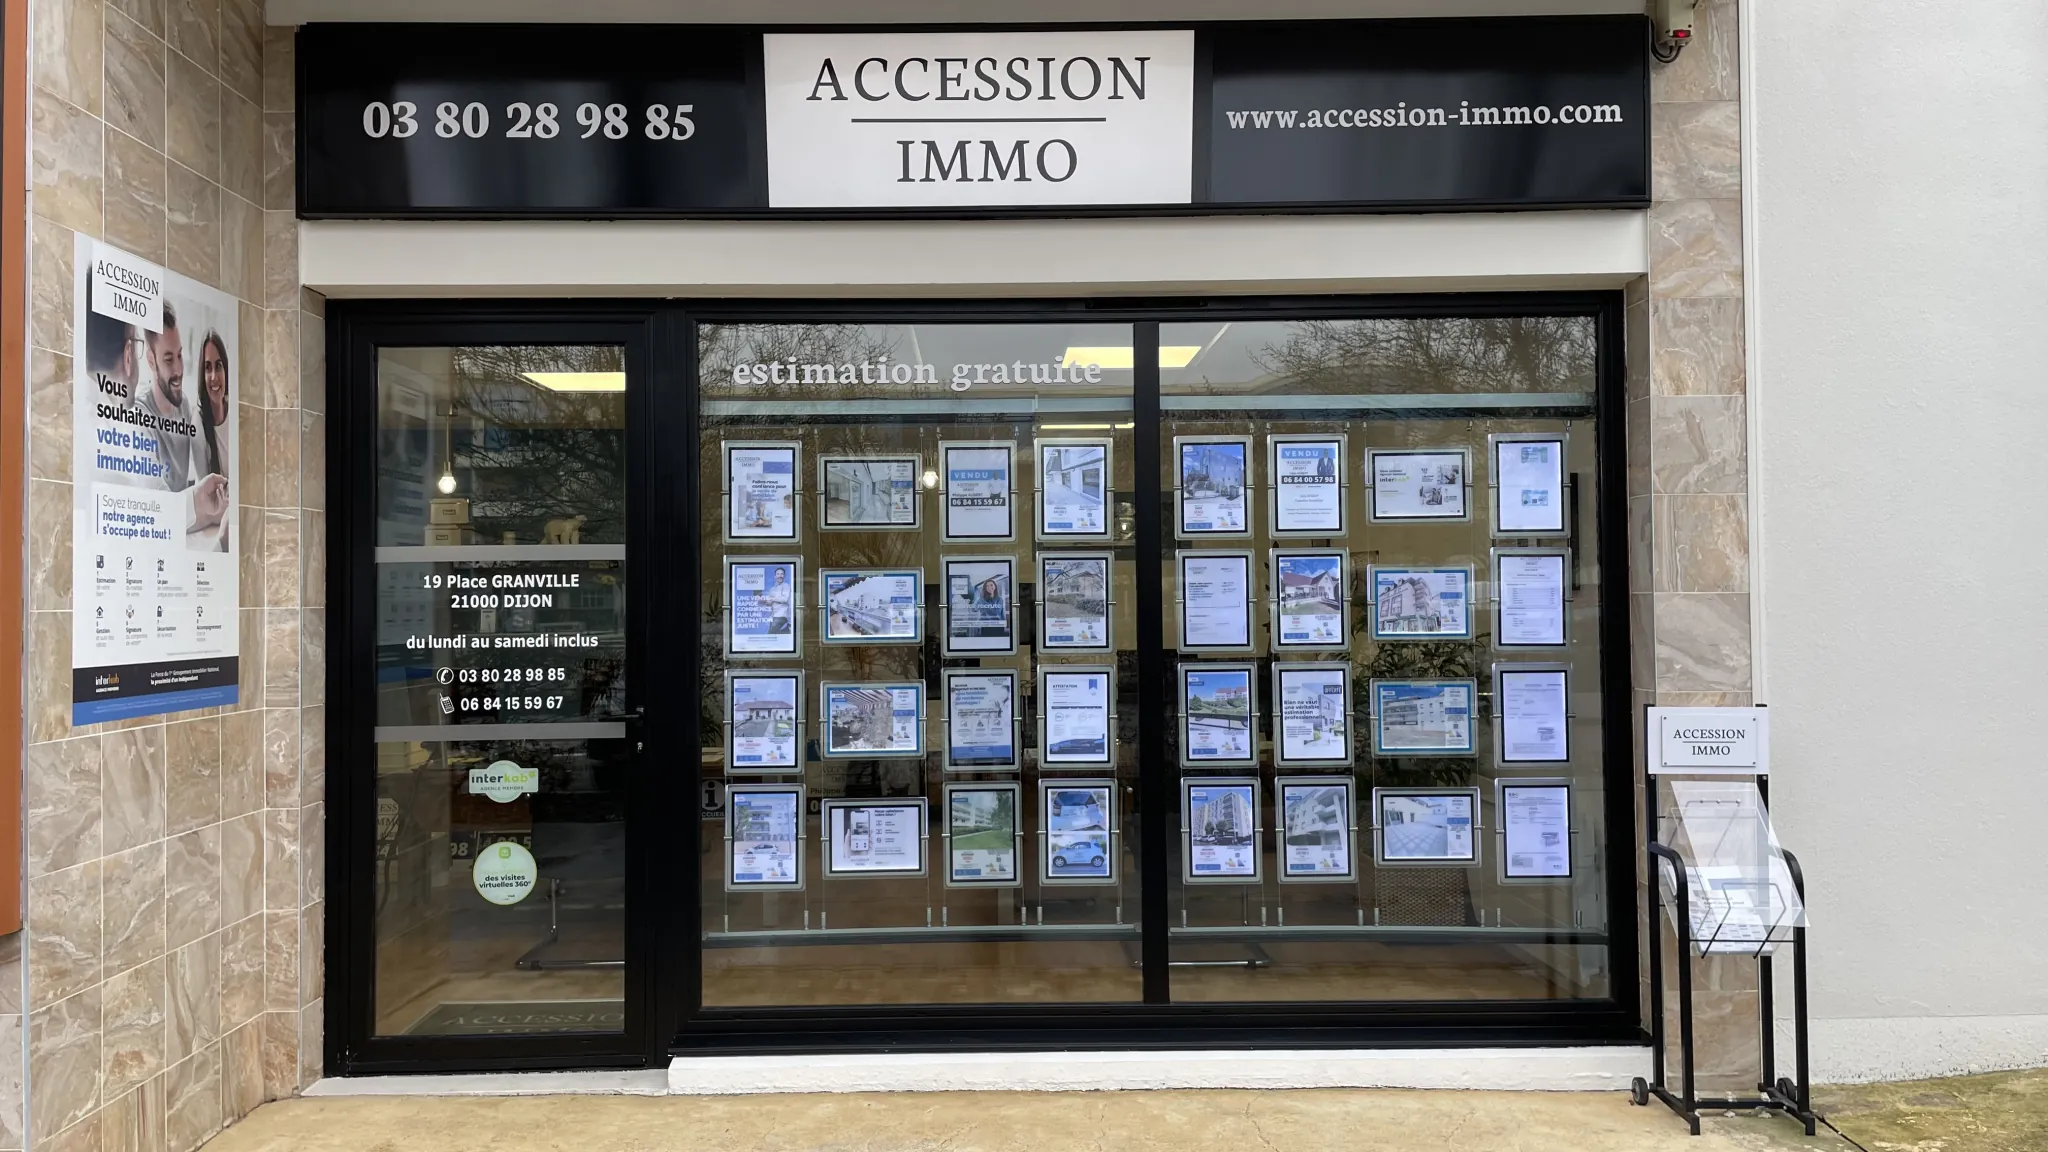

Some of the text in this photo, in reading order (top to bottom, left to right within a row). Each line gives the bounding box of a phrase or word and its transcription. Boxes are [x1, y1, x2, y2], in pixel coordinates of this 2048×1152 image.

[806, 56, 1151, 102] ACCESSION
[363, 101, 695, 140] 03 80 28 98 85
[1226, 100, 1623, 130] www.accession-immo.com
[897, 139, 1078, 183] IMMO
[97, 260, 159, 296] ACCESSION
[113, 292, 147, 318] IMMO
[733, 356, 1102, 392] estimation gratuite
[97, 373, 128, 398] Vous
[97, 403, 197, 438] souhaitez vendre
[97, 427, 158, 453] votre bien
[97, 449, 163, 477] immobilier
[103, 494, 126, 510] Soyez
[103, 510, 155, 526] notre agence
[103, 523, 138, 540] s'occupe
[140, 526, 150, 538] de
[151, 528, 167, 540] tout
[423, 574, 580, 589] 19 Place GRANVILLE
[451, 594, 553, 609] 21000 DIJON
[406, 633, 599, 649] du lundi au samedi inclus
[459, 668, 565, 683] 03 80 28 98 85
[460, 696, 563, 711] 06 84 15 59 67
[1673, 729, 1746, 740] ACCESSION
[1692, 745, 1731, 756] IMMO
[500, 873, 526, 881] visites
[442, 1013, 624, 1026] ACCESSIO
